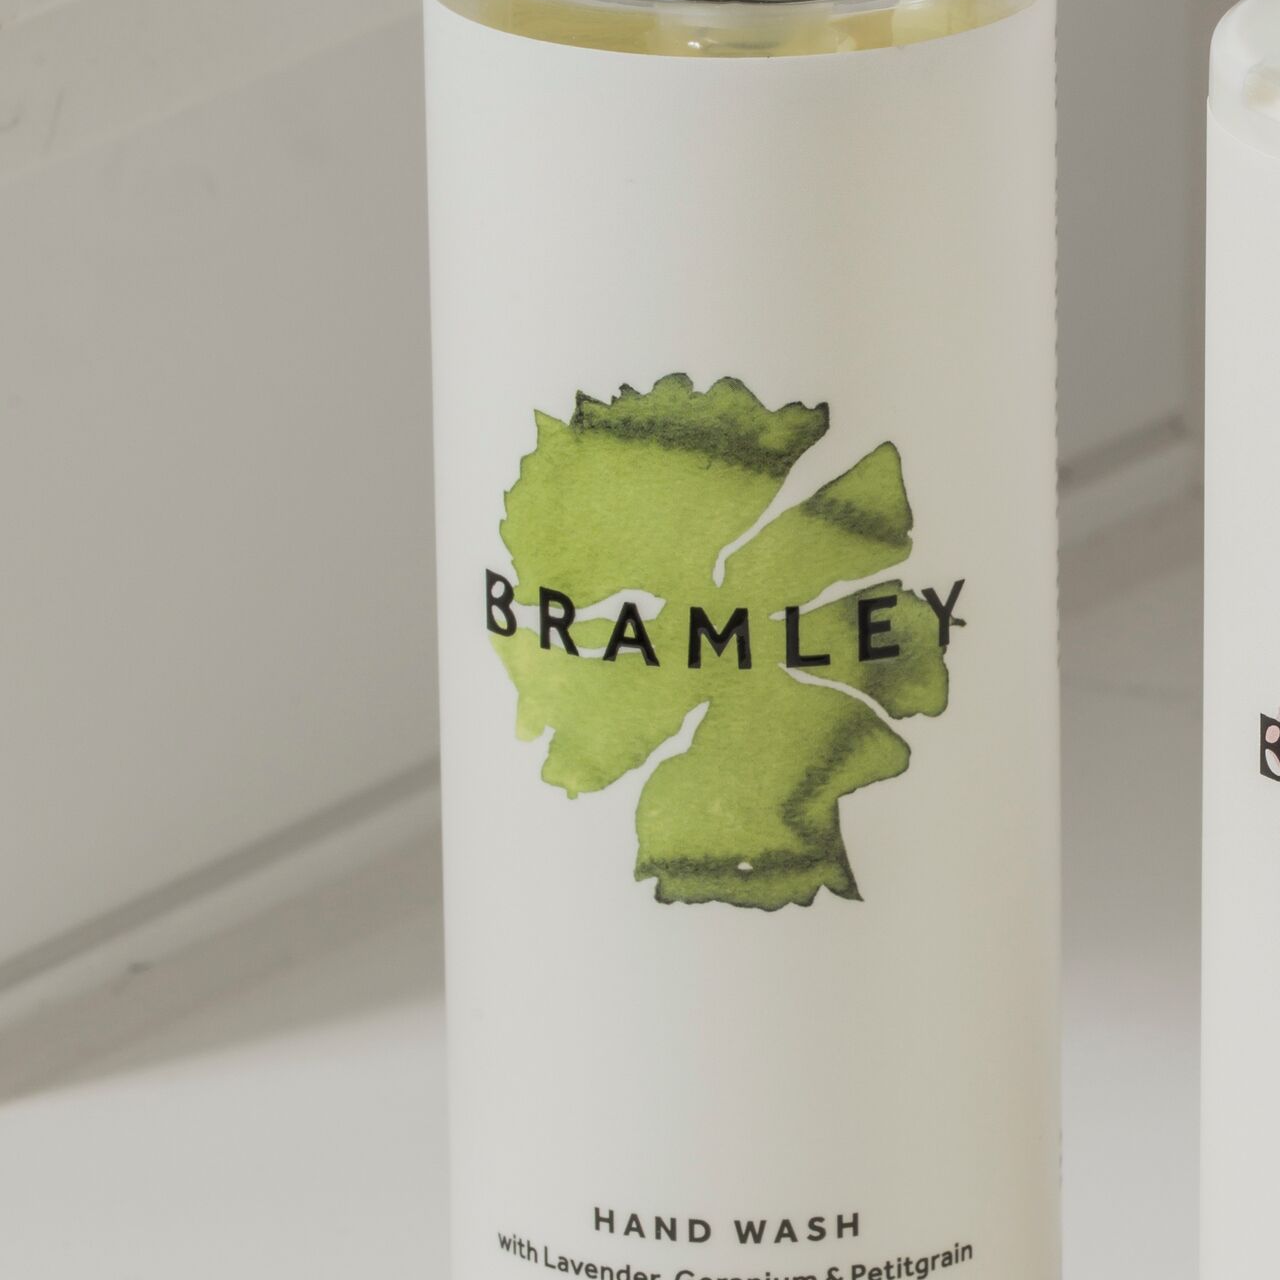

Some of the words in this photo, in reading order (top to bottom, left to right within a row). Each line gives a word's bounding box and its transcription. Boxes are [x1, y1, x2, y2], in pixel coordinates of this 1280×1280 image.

[485, 569, 965, 670] BRAMLEY
[593, 1206, 712, 1244] HAND
[733, 1211, 860, 1245] WASH
[497, 1232, 539, 1264] with
